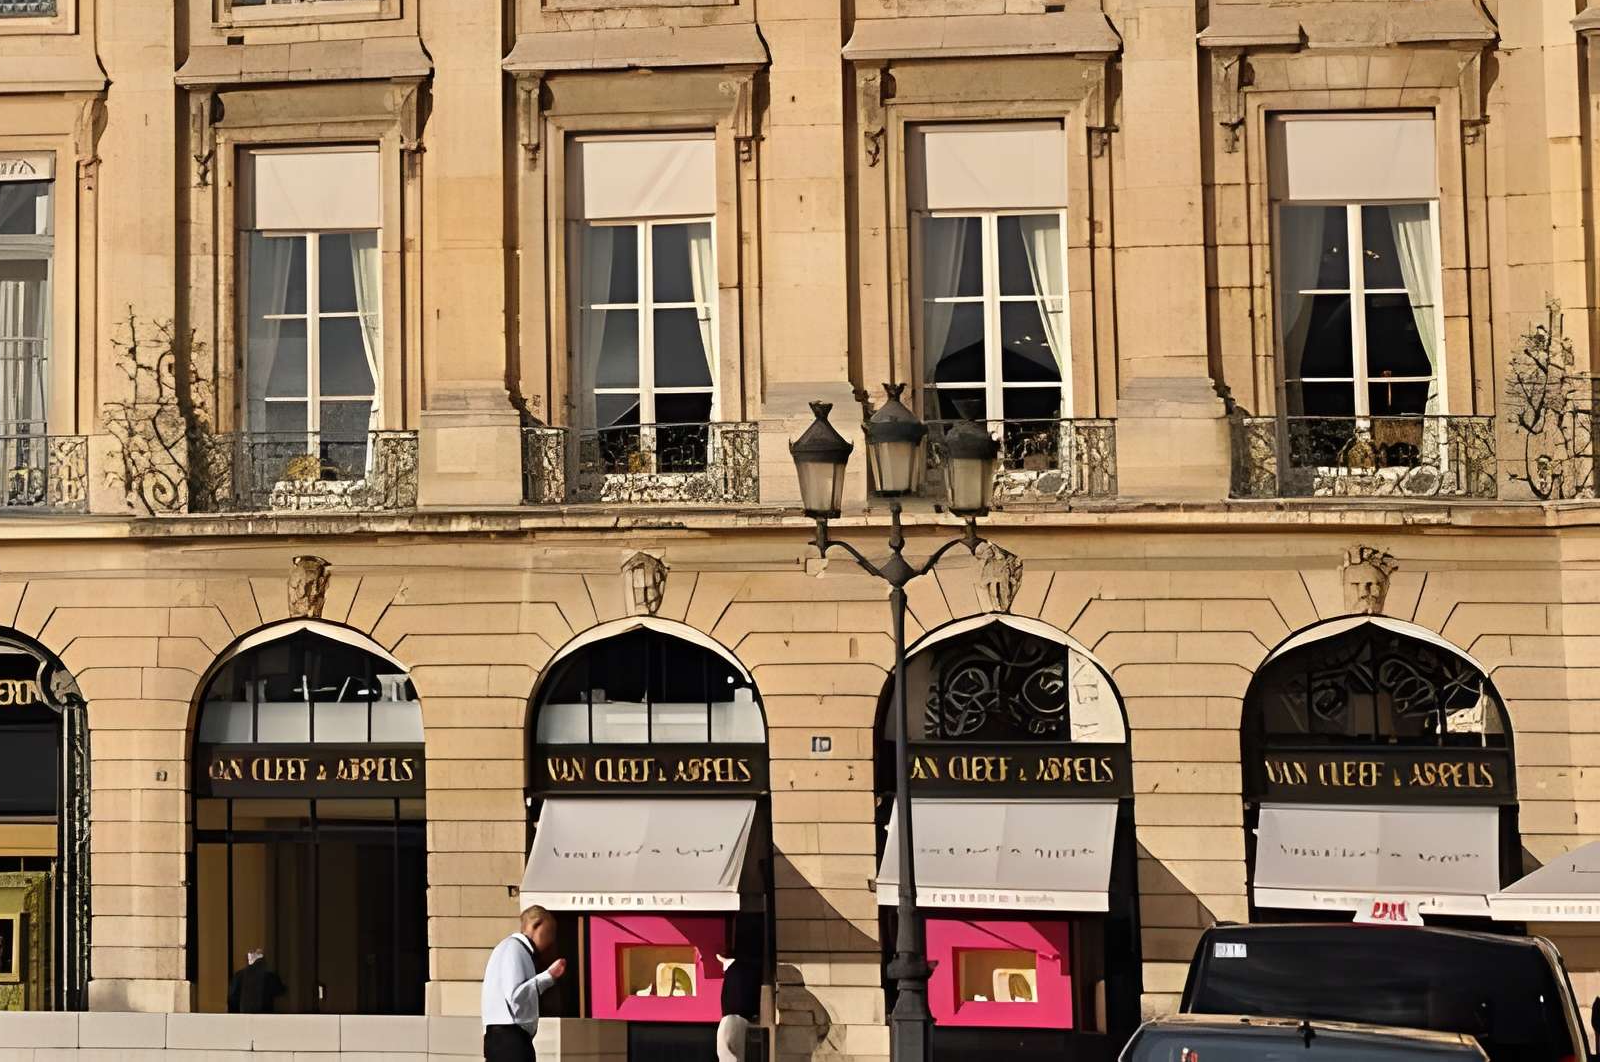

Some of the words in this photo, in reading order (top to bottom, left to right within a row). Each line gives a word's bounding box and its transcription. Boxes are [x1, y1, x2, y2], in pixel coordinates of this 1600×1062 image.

[909, 755, 940, 780] AN
[948, 755, 1013, 782] CLEEF
[1318, 761, 1386, 787] CLEEF
